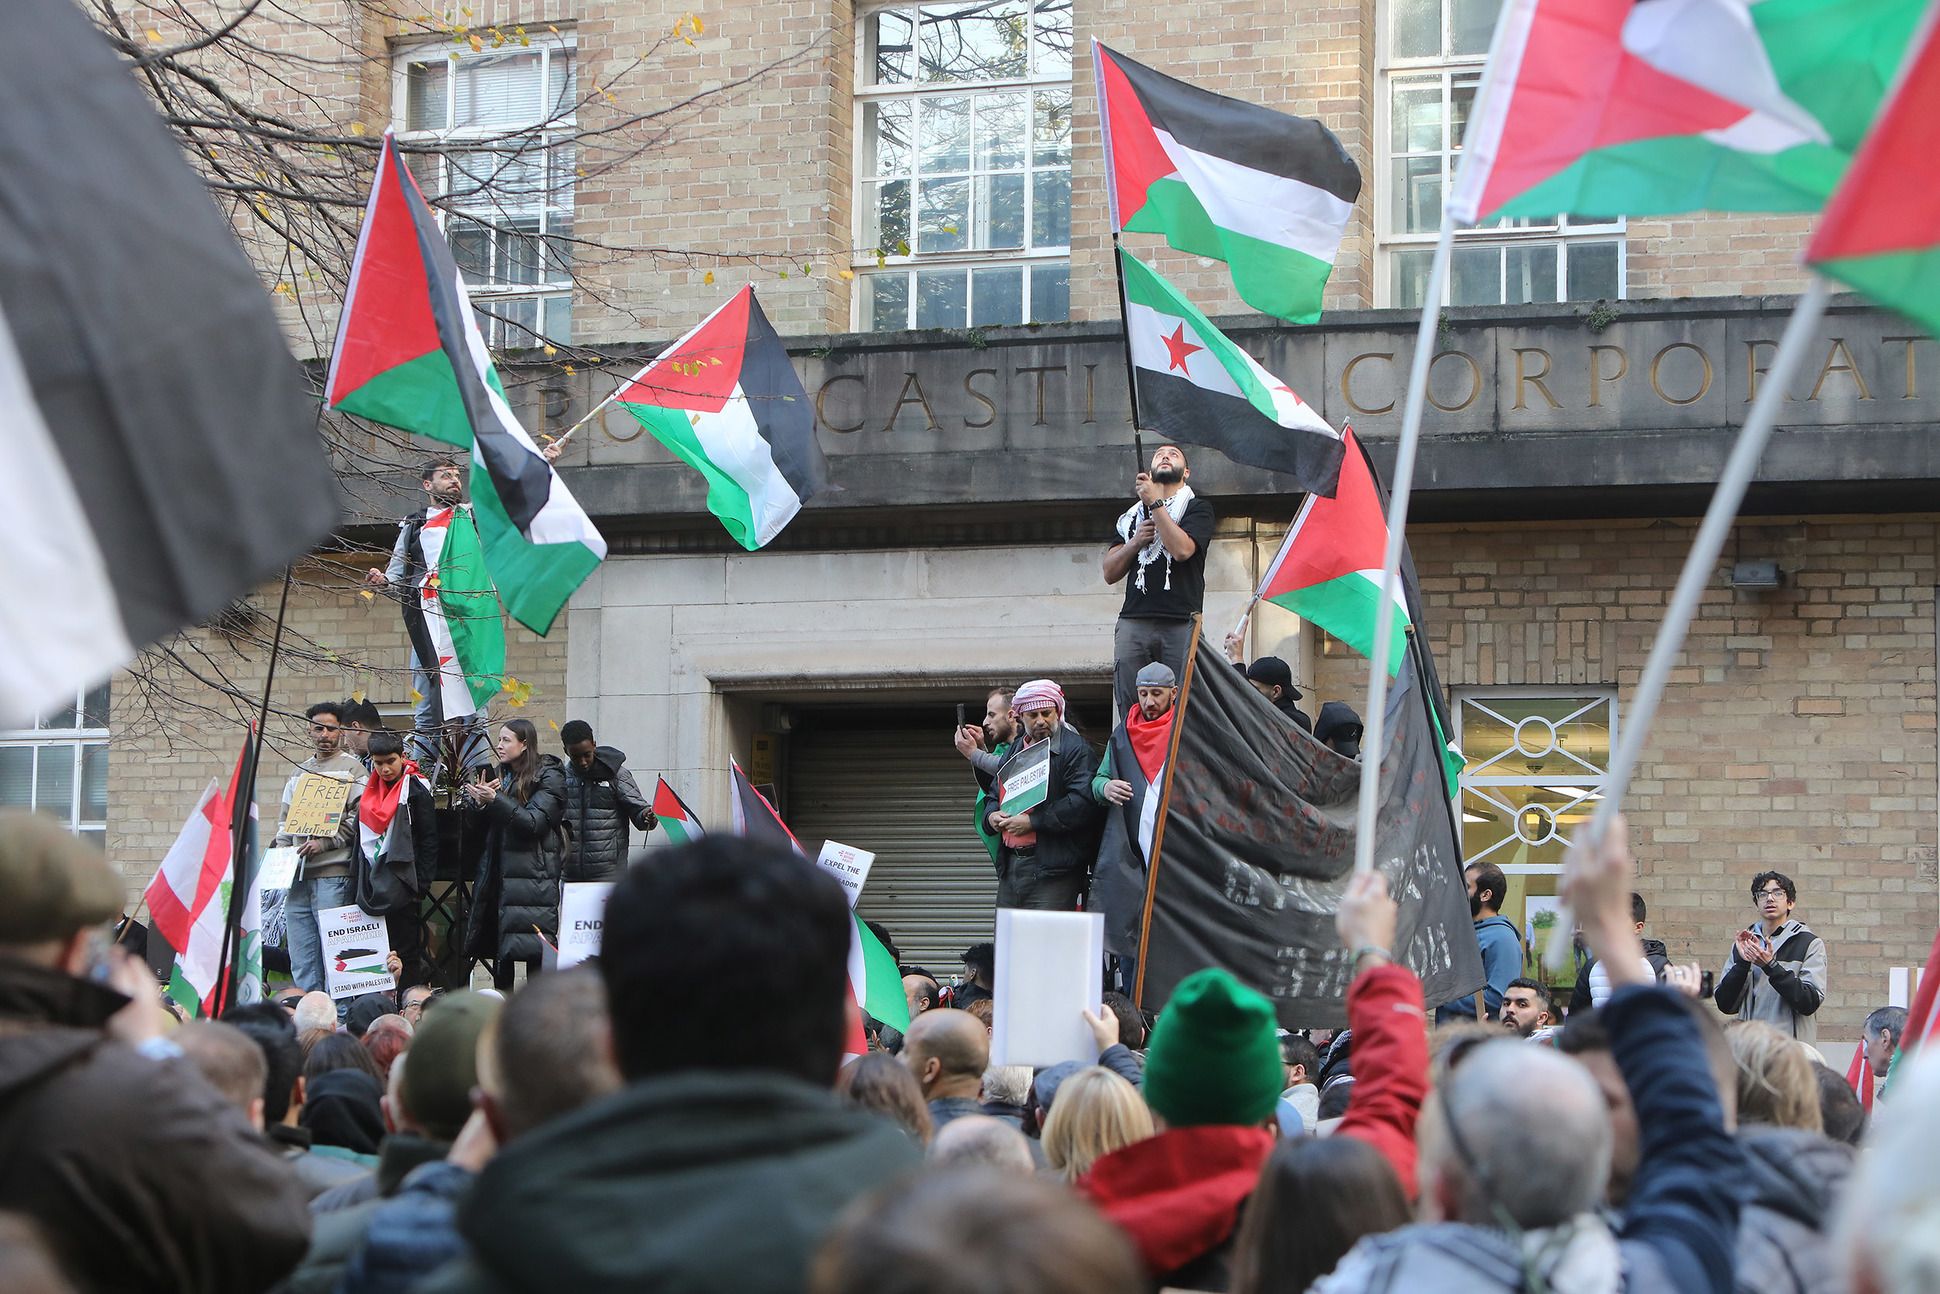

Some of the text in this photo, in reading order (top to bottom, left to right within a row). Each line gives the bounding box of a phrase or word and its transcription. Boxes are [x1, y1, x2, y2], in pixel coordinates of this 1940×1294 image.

[301, 778, 348, 800] FREE!
[824, 858, 845, 871] EXPEL
[846, 865, 861, 876] THE
[327, 922, 380, 938] END ISRAELI
[575, 920, 604, 931] END
[334, 977, 392, 993] STAND WITH PALESTINE
